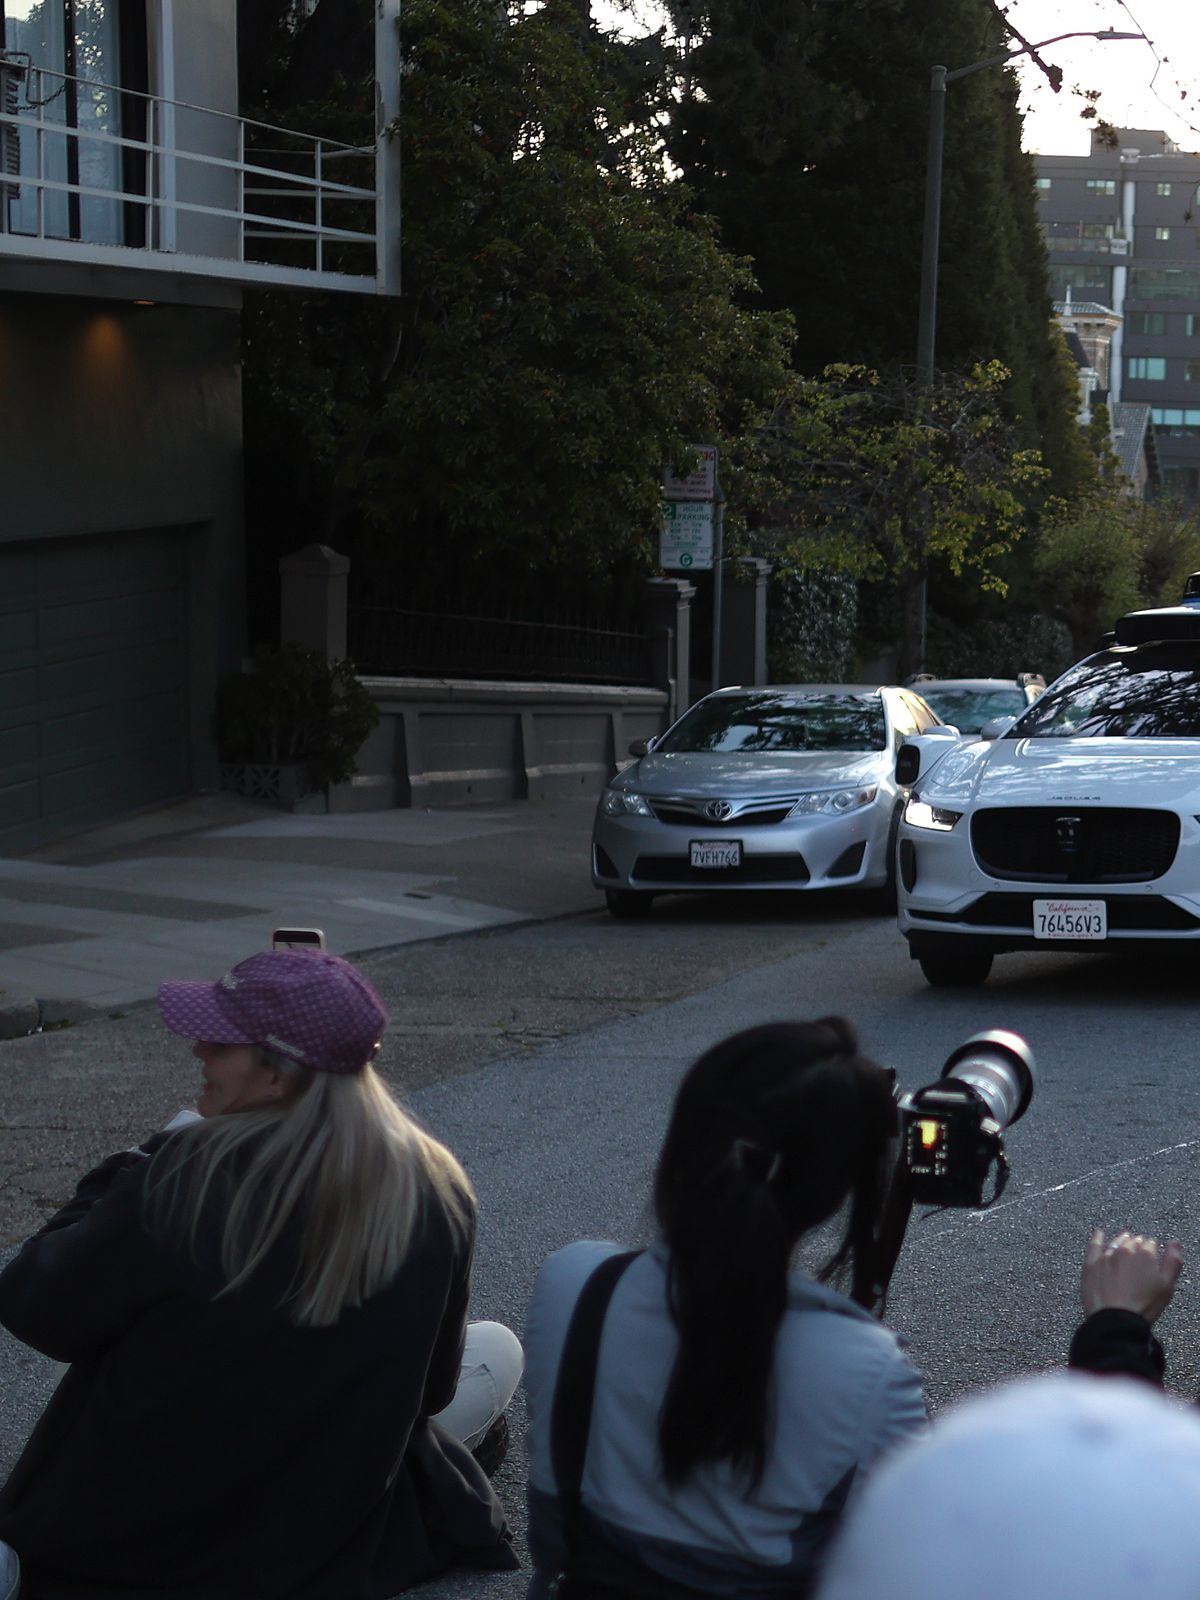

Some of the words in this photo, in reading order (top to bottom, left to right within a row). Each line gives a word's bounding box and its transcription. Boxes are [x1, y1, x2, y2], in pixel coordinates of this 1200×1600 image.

[664, 505, 673, 519] 2
[683, 504, 704, 513] HOUR
[677, 513, 711, 521] PARKING
[693, 850, 737, 865] 7VFH766
[1048, 903, 1090, 914] California
[1038, 915, 1102, 933] 76456V3
